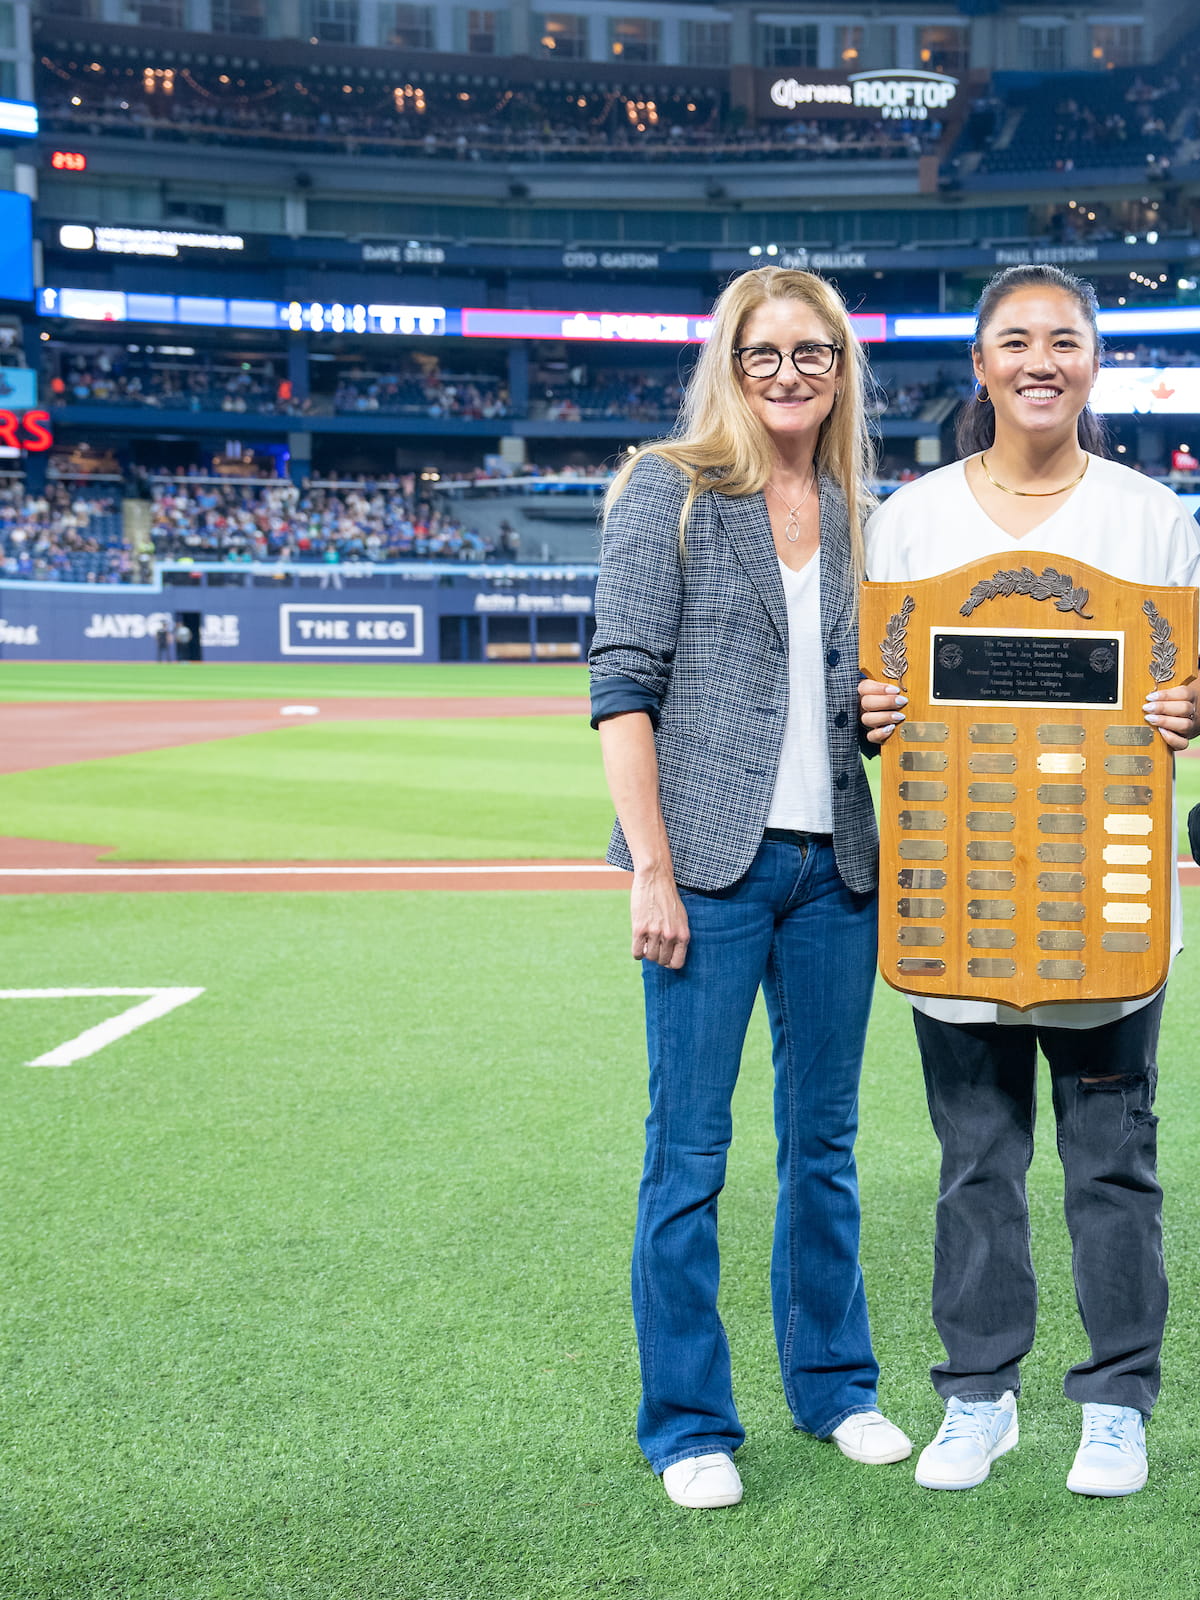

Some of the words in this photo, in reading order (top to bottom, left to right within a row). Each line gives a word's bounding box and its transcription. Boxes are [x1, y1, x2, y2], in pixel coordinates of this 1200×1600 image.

[853, 81, 956, 108] ROOFTOP
[881, 106, 928, 120] PATIO
[362, 245, 400, 261] DAVE
[562, 252, 597, 267] CITO
[601, 252, 659, 268] GASTON
[84, 613, 146, 638] JAYS
[146, 612, 239, 636] CRE
[297, 620, 349, 640] THE
[356, 620, 408, 640] KEG
